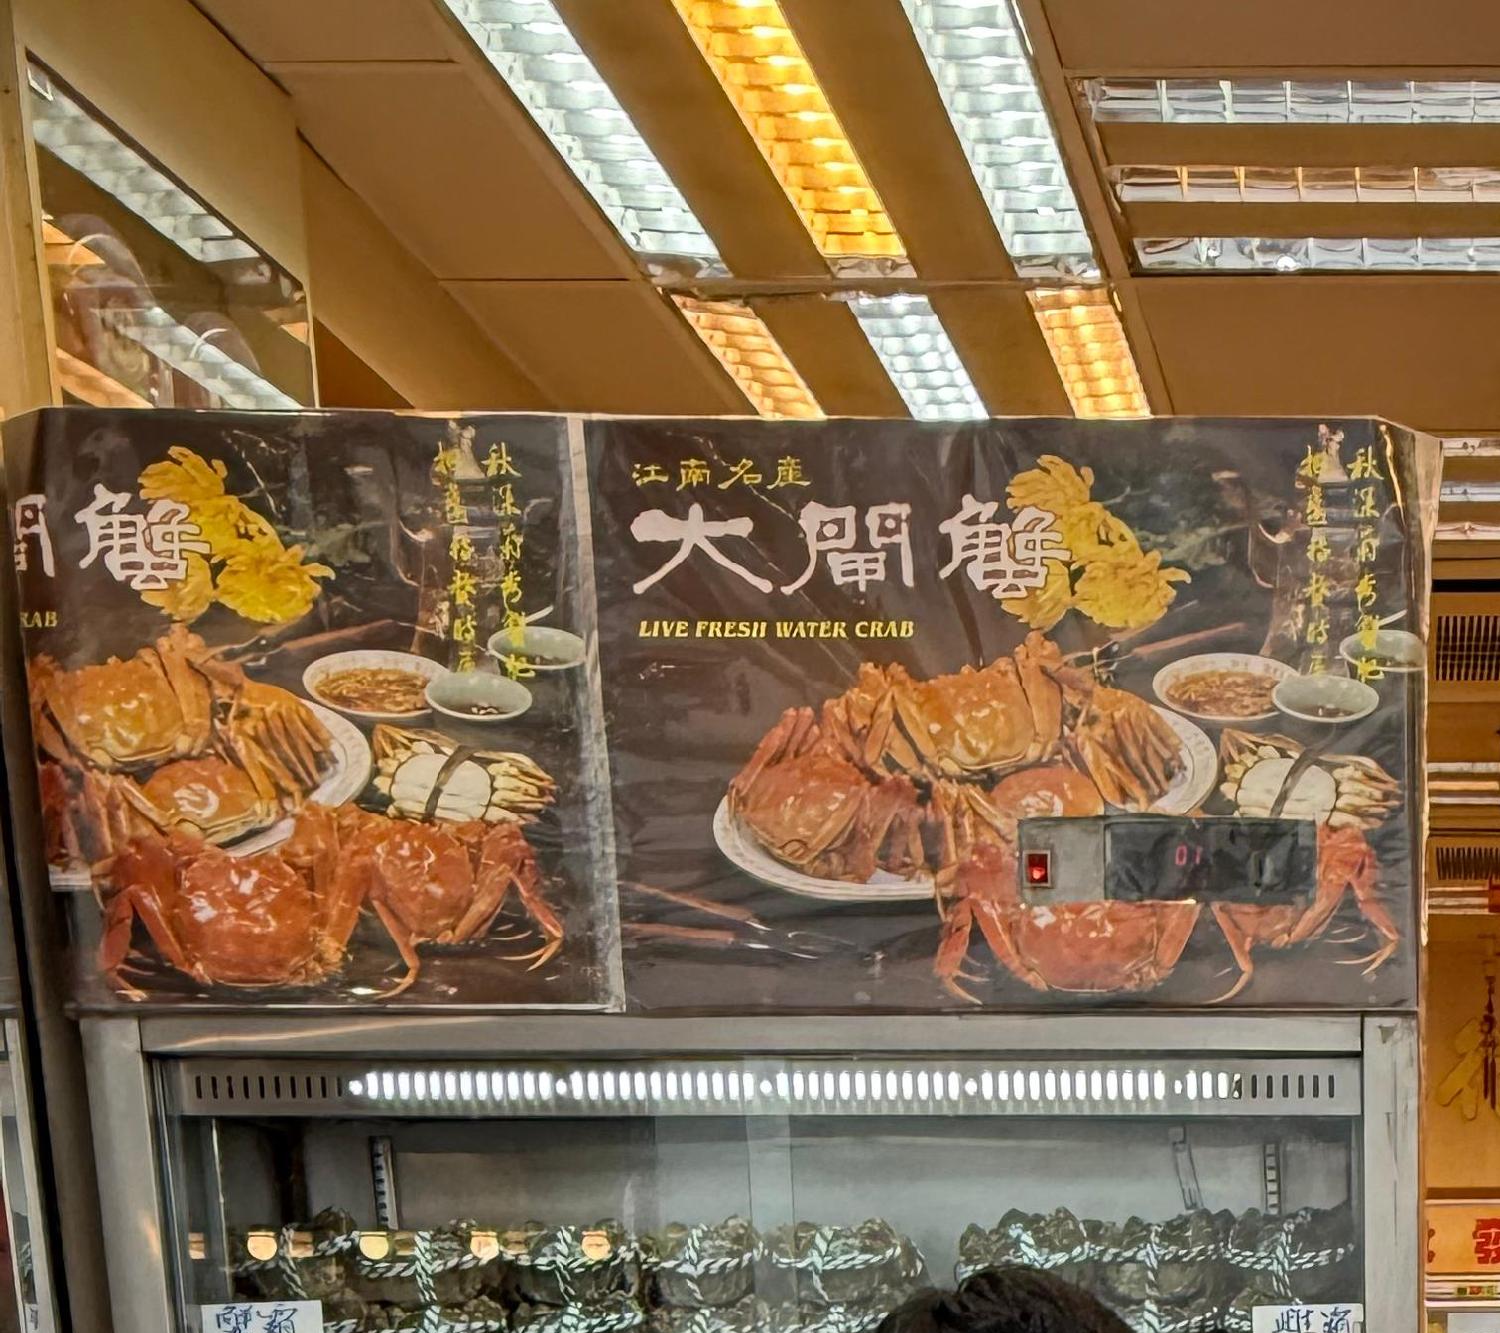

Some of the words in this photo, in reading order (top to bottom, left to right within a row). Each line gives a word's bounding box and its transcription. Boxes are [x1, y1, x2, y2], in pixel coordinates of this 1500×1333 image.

[629, 493, 1072, 599] 大閘蟹
[638, 620, 689, 639] LIVE
[694, 620, 768, 640] FRESH
[776, 620, 849, 640] WATER
[854, 620, 915, 639] CRAB
